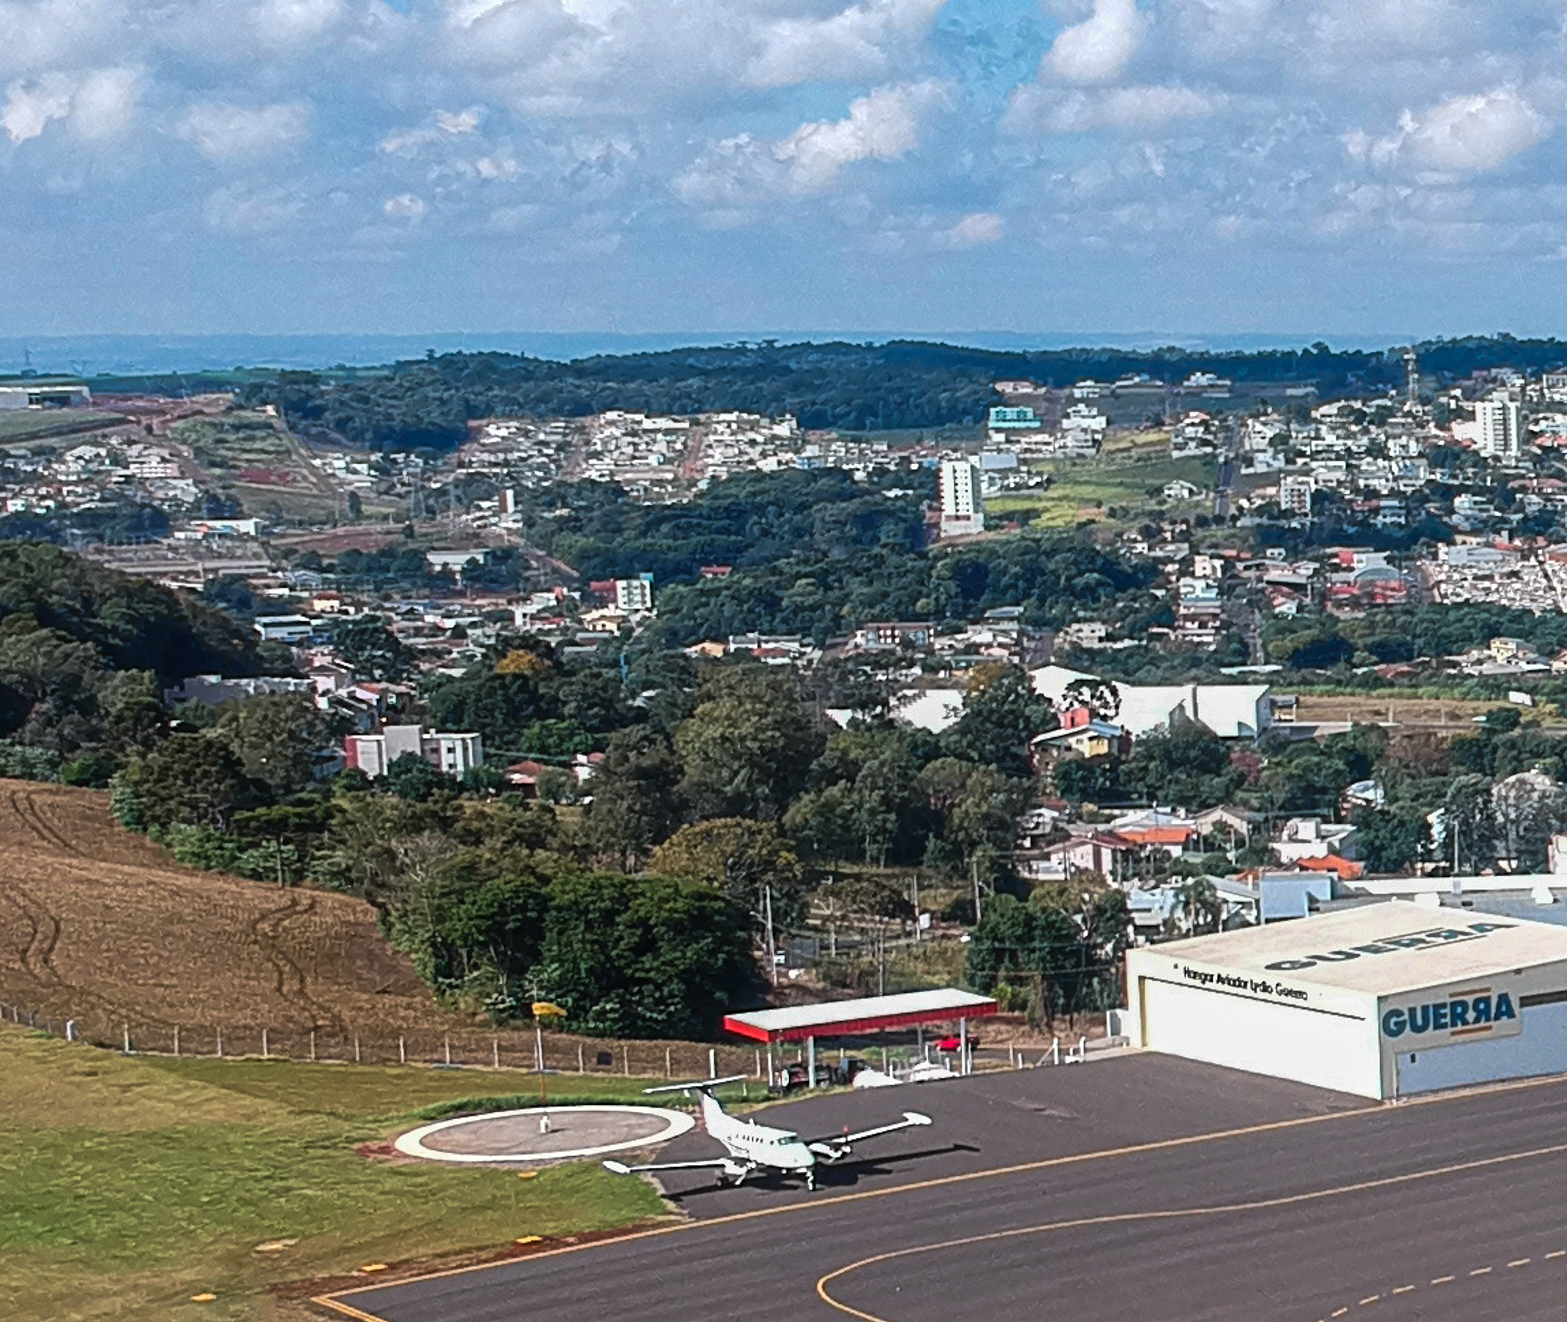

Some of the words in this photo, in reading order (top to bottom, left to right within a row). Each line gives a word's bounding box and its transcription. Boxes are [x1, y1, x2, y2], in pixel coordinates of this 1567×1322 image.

[1264, 922, 1520, 970] GUERRA
[1183, 966, 1214, 985] Hangar
[1216, 973, 1249, 990] Aviador
[1382, 992, 1516, 1038] GUERRA
